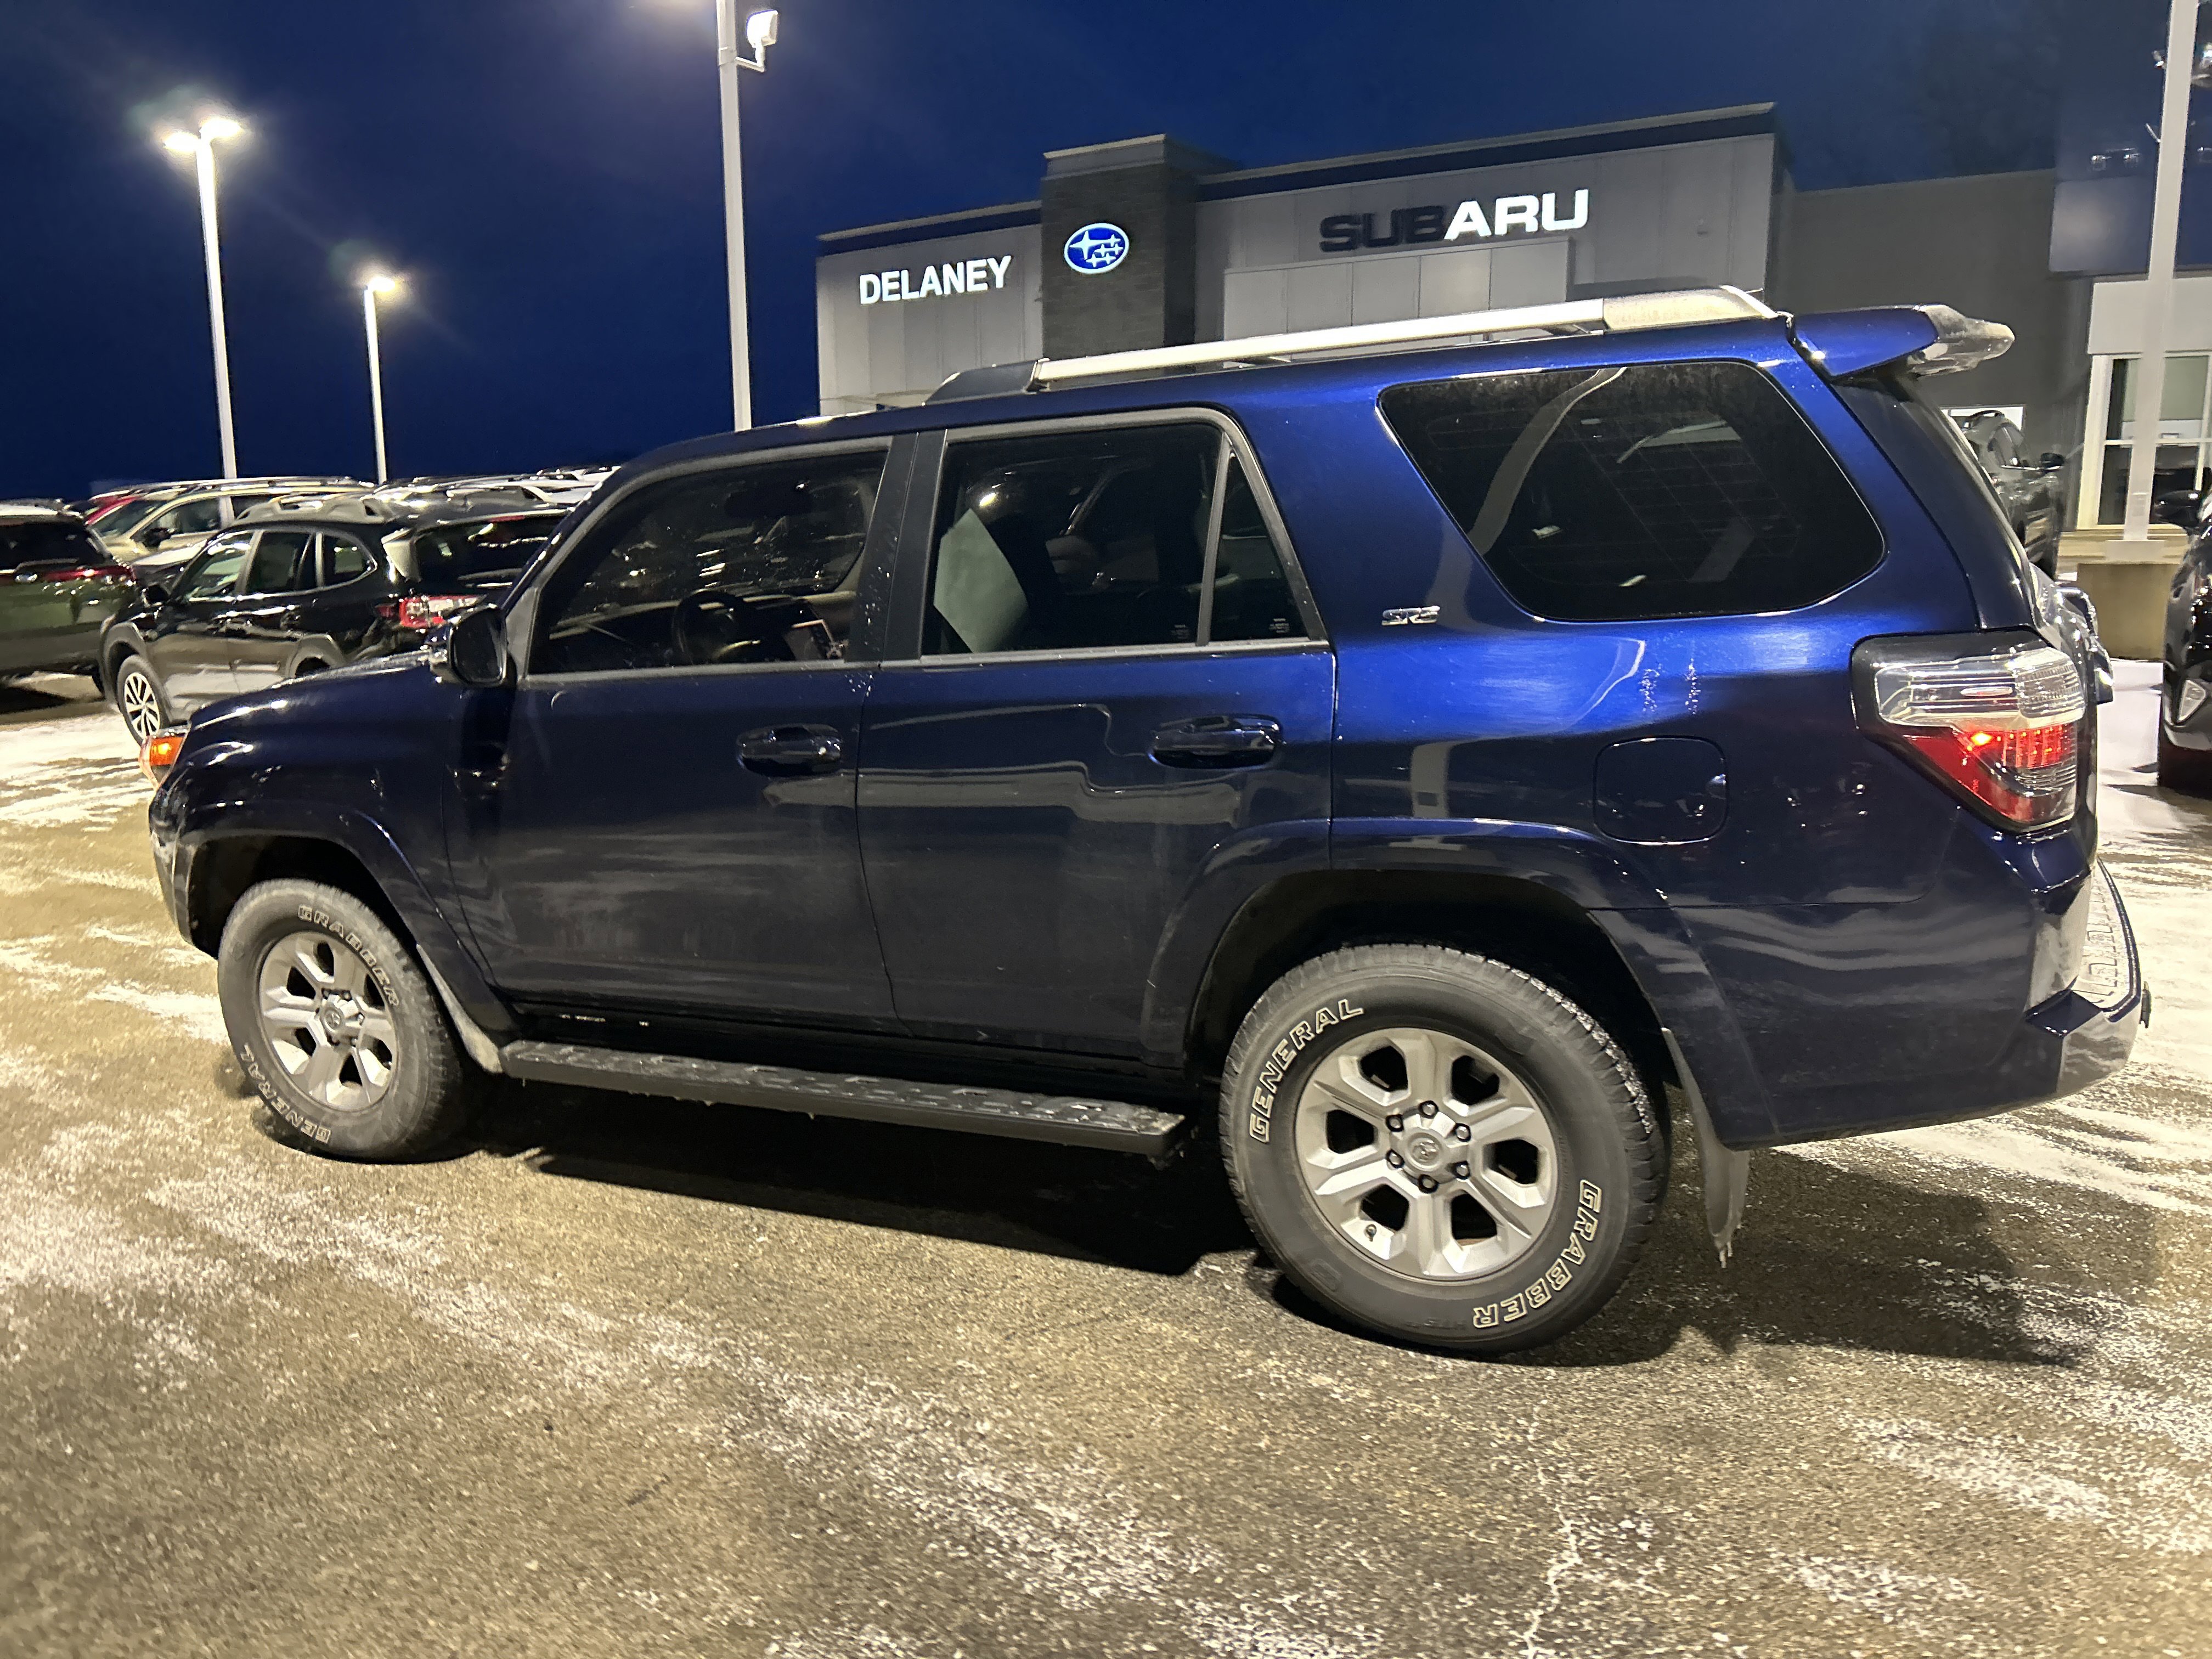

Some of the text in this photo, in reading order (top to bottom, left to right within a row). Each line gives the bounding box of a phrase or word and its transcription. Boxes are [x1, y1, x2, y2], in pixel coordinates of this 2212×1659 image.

[1319, 189, 1589, 252] SUBARU
[859, 256, 1011, 304] DELANEY
[298, 905, 399, 1006] GRABBER
[240, 1043, 331, 1143] GENERAL
[1249, 999, 1364, 1143] GENERAL
[1473, 1180, 1602, 1328] GRABBER
